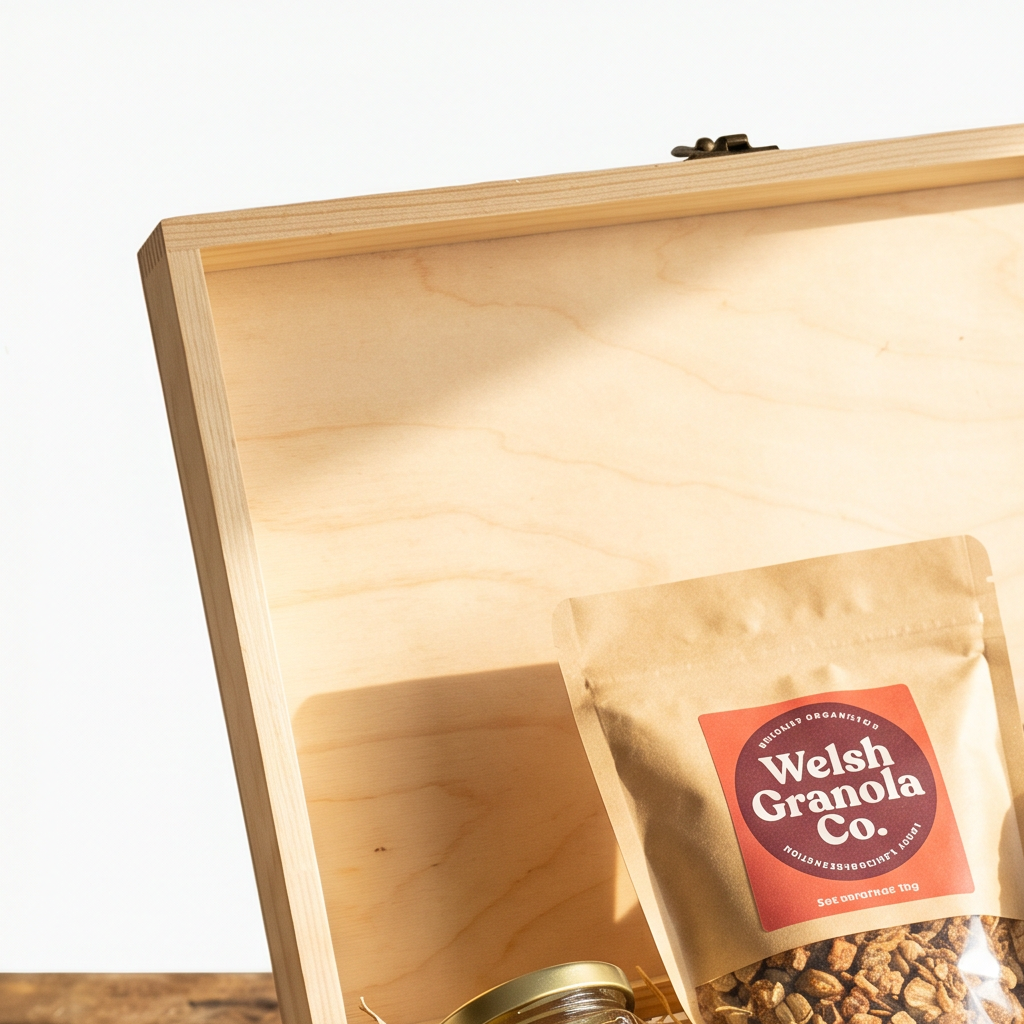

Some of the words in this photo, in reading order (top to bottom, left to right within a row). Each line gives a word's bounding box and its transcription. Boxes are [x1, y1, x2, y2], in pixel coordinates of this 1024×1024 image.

[758, 736, 895, 785] Welsh
[752, 767, 926, 822] Granola
[816, 813, 888, 846] Co.
